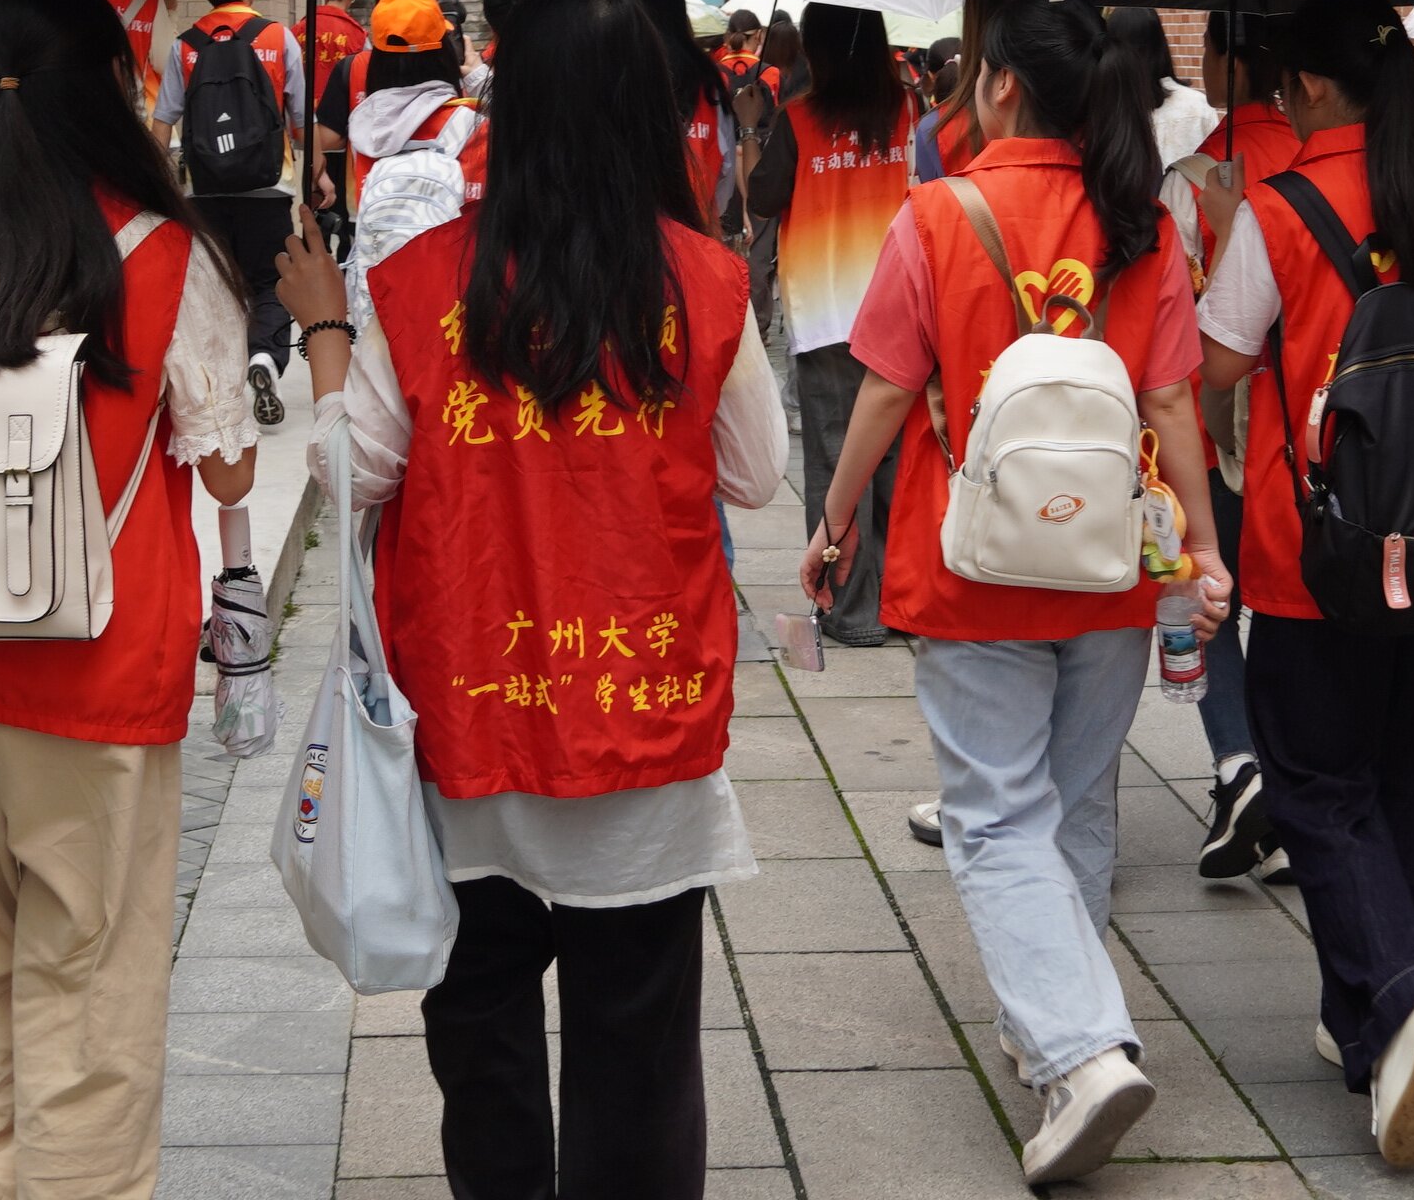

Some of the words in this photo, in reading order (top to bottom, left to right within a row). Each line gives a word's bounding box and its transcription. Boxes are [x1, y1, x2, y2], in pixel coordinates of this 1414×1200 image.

[811, 145, 907, 175] 劳动教育实践
[501, 610, 680, 658] 广州大学
